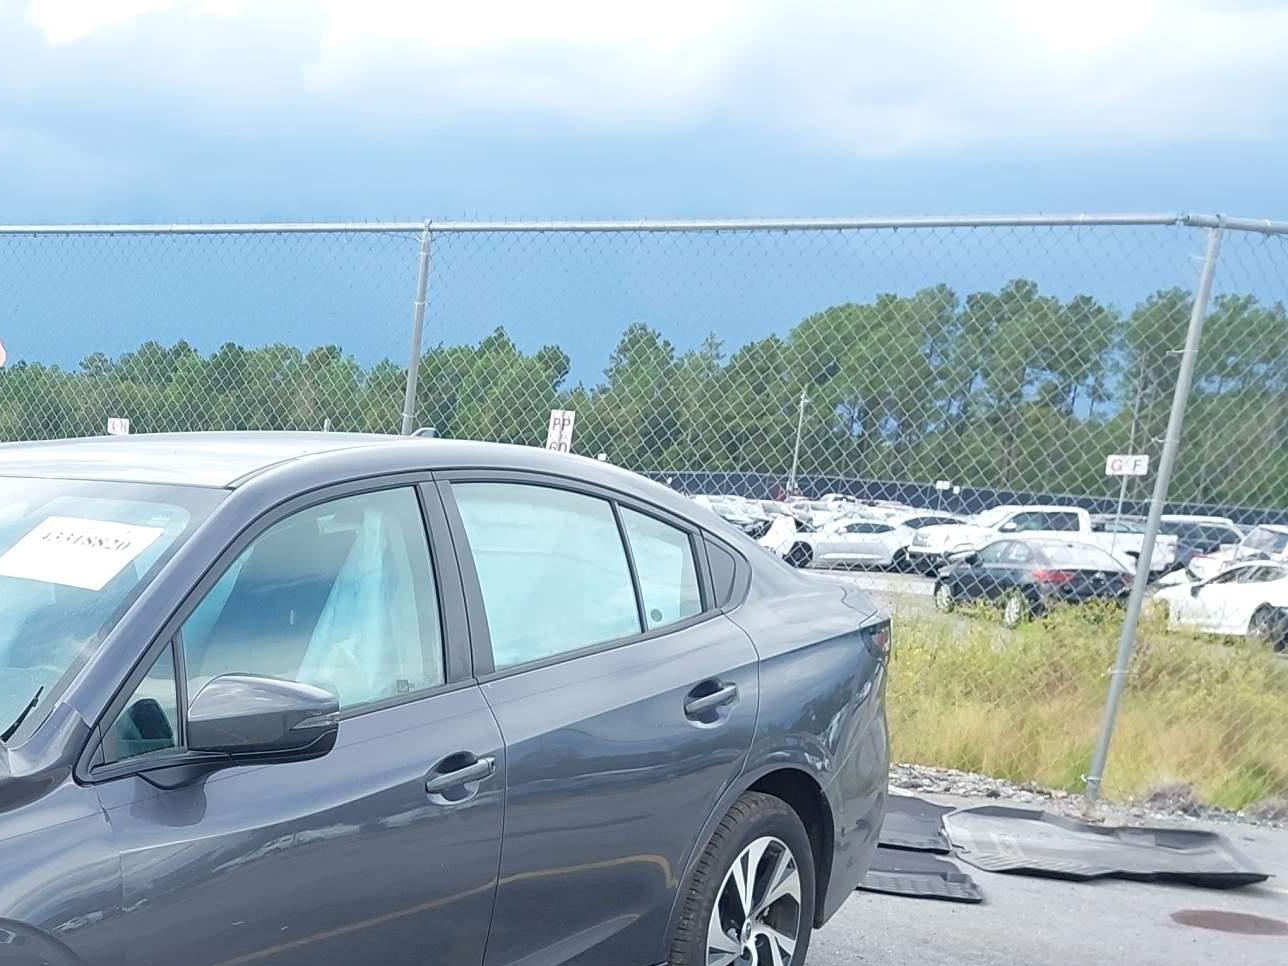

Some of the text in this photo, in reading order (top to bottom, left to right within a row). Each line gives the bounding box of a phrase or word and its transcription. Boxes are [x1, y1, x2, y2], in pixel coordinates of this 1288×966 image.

[552, 417, 571, 430] PP
[1110, 458, 1143, 472] G F
